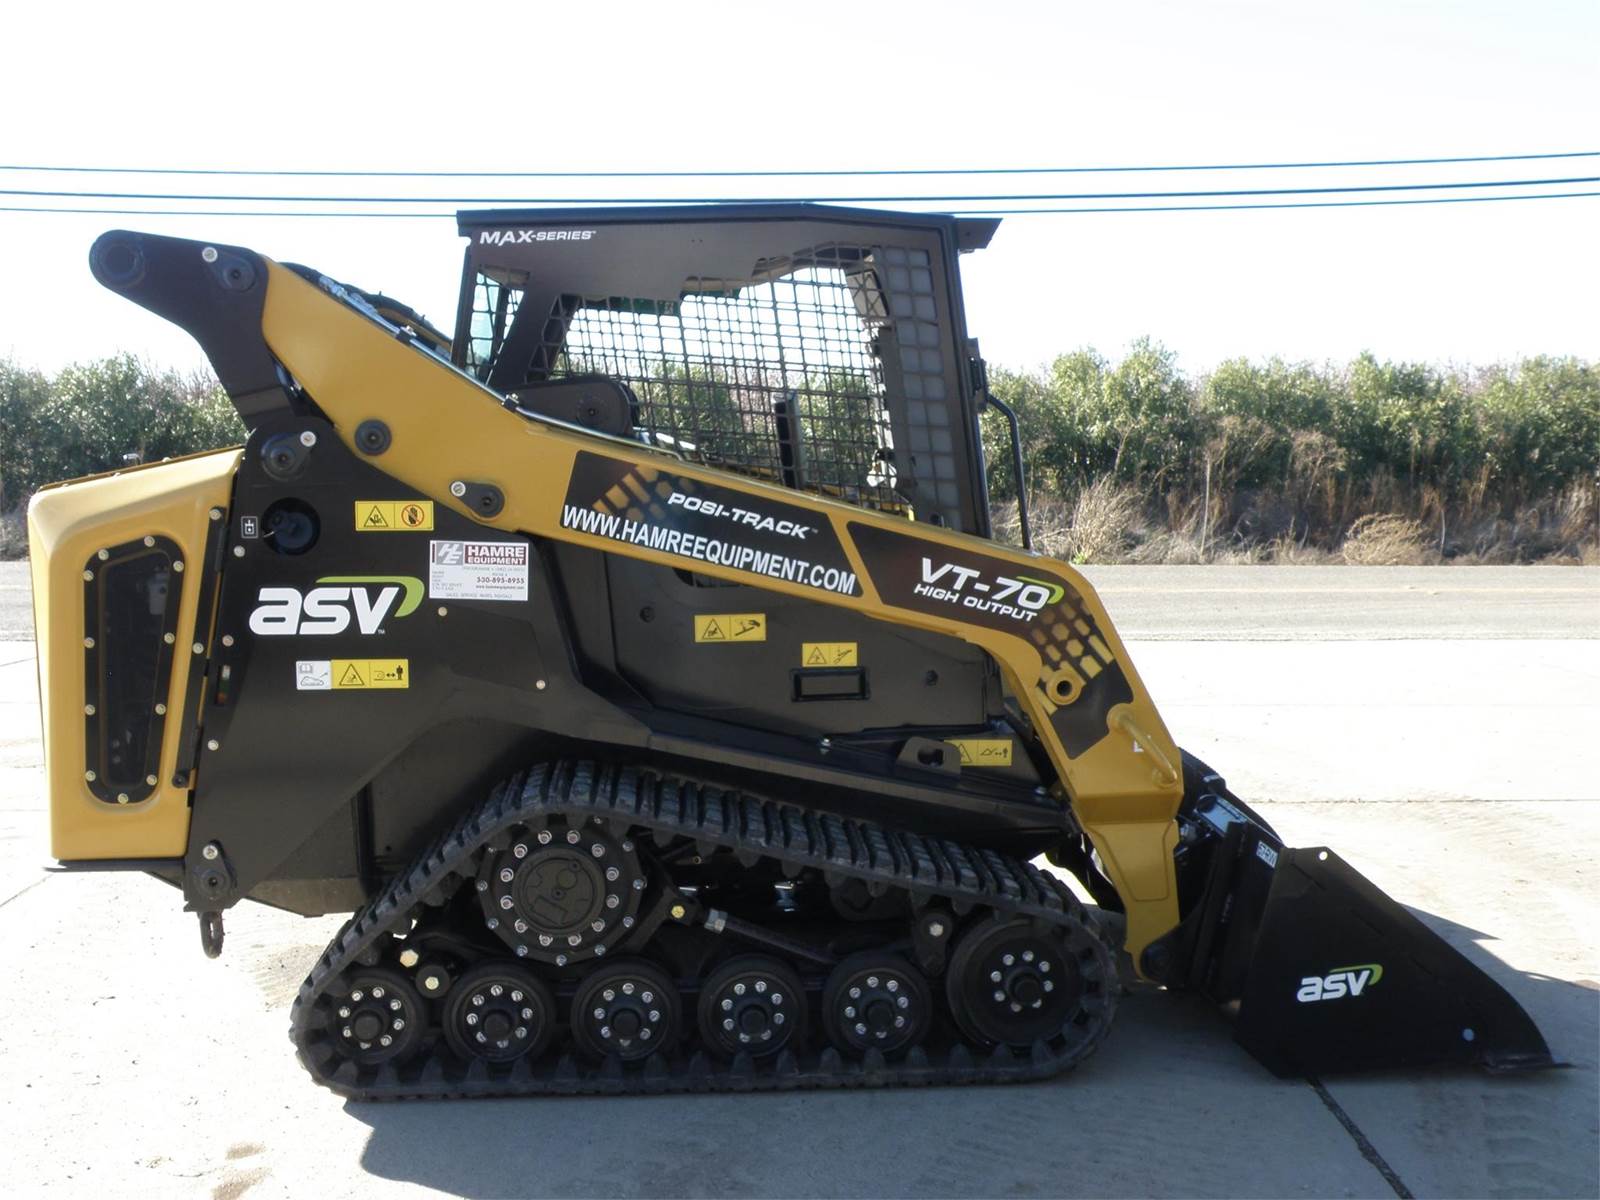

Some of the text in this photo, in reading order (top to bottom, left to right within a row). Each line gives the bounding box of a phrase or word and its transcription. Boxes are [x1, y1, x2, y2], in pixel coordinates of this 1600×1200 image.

[667, 492, 817, 540] POSI-TRACK
[467, 546, 525, 558] HAMRE
[467, 556, 525, 566] EQUIPMENT
[563, 504, 856, 596] WWW.HAMREEQUIPMENT.COM
[913, 582, 1038, 623] HIGH OUTPUT
[921, 556, 1051, 611] VT-70
